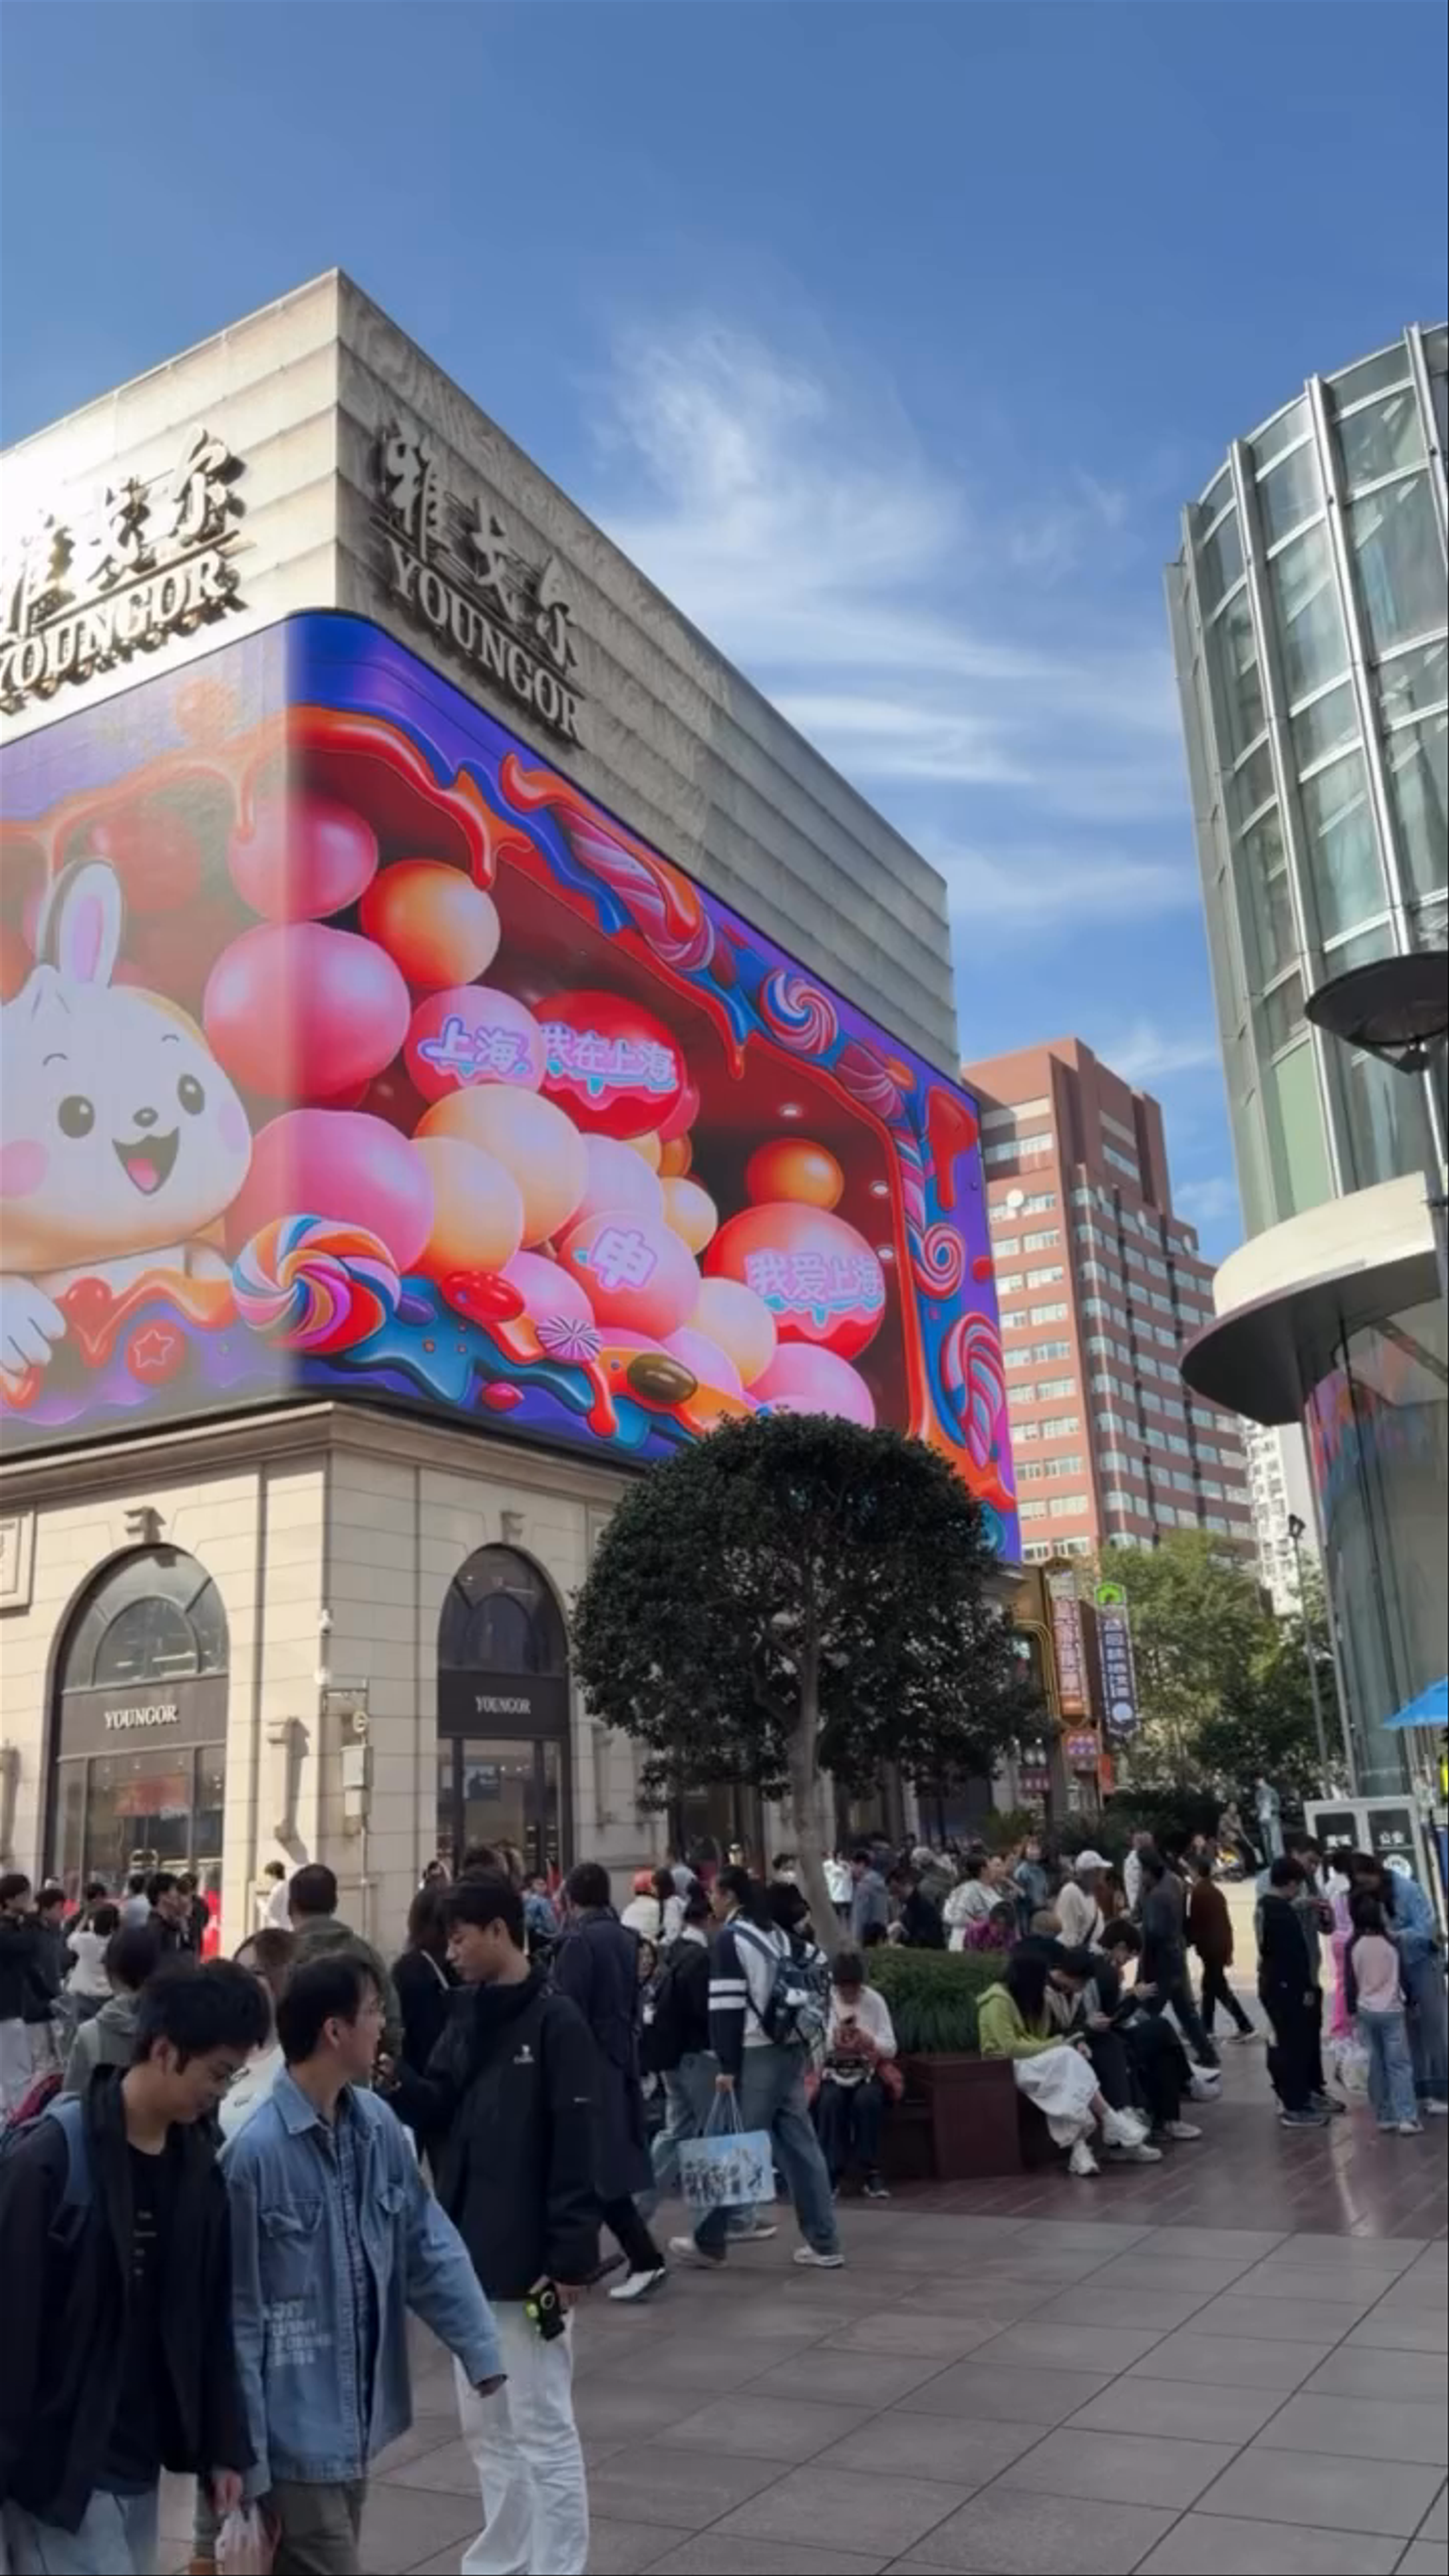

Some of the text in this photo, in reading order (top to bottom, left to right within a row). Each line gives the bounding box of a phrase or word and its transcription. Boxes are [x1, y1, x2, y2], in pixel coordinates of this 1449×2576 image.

[384, 535, 582, 740] YOUNGOR
[419, 1016, 527, 1075] 上海
[539, 1022, 676, 1084] 我在上海
[592, 1226, 658, 1288] 申
[748, 1250, 880, 1300] 我爱上海
[104, 1704, 178, 1729] YOUNGOR
[474, 1696, 531, 1714] YOUNGOR
